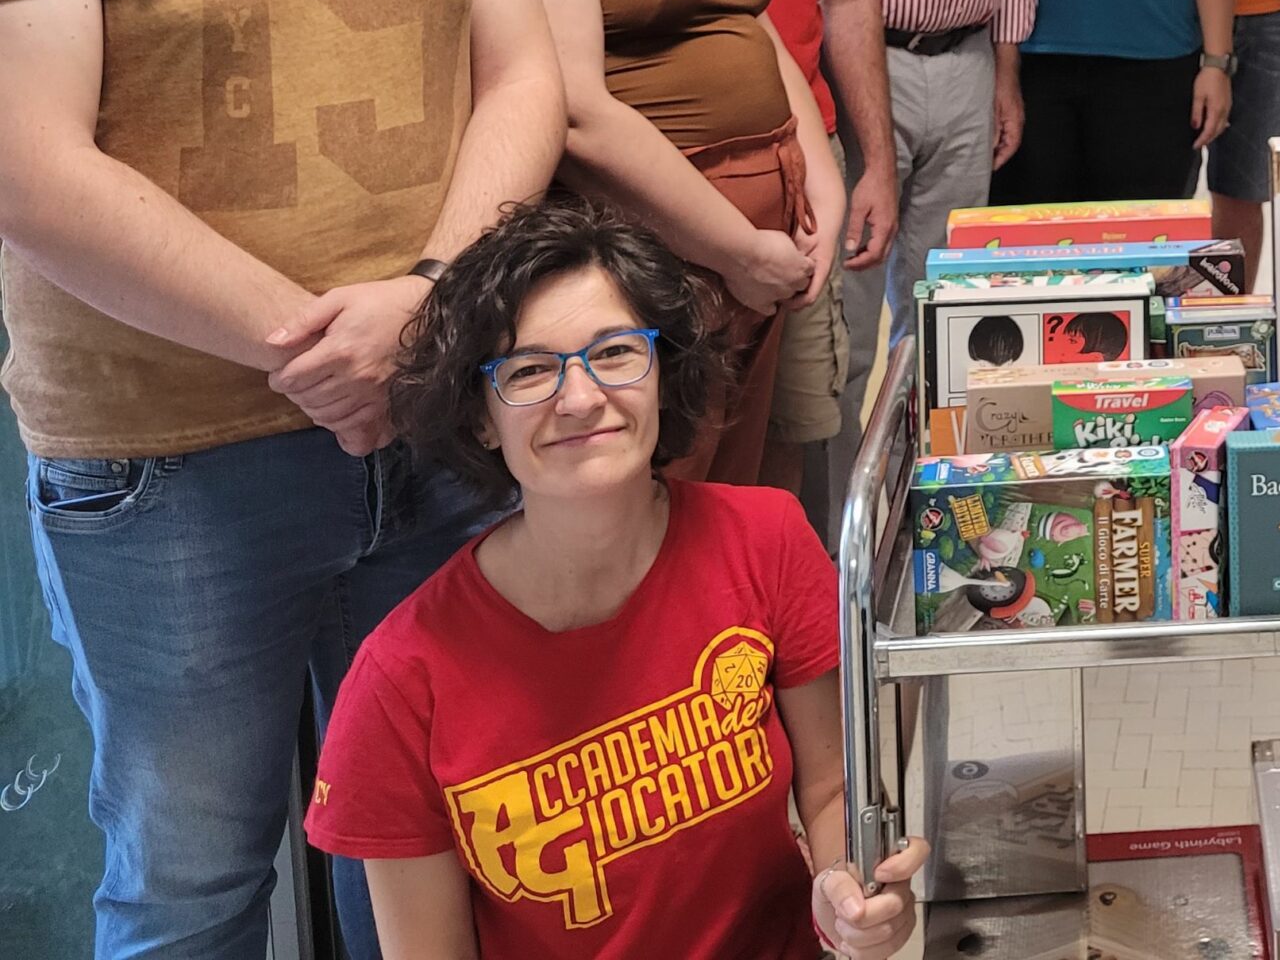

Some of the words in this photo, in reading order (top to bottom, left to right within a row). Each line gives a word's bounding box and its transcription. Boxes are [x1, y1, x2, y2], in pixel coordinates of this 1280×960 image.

[976, 397, 1018, 434] Crazy
[1094, 392, 1150, 409] Travel
[1073, 413, 1136, 448] Kiki
[1098, 527, 1110, 561] Gioco
[1140, 542, 1151, 578] SUPER
[926, 552, 936, 591] GRANNA
[1099, 563, 1110, 575] di
[1111, 508, 1143, 614] FARMER
[1099, 578, 1110, 609] Carte
[736, 674, 753, 688] 20
[1129, 840, 1171, 851] Game
[1175, 836, 1242, 849] Labyrinth
